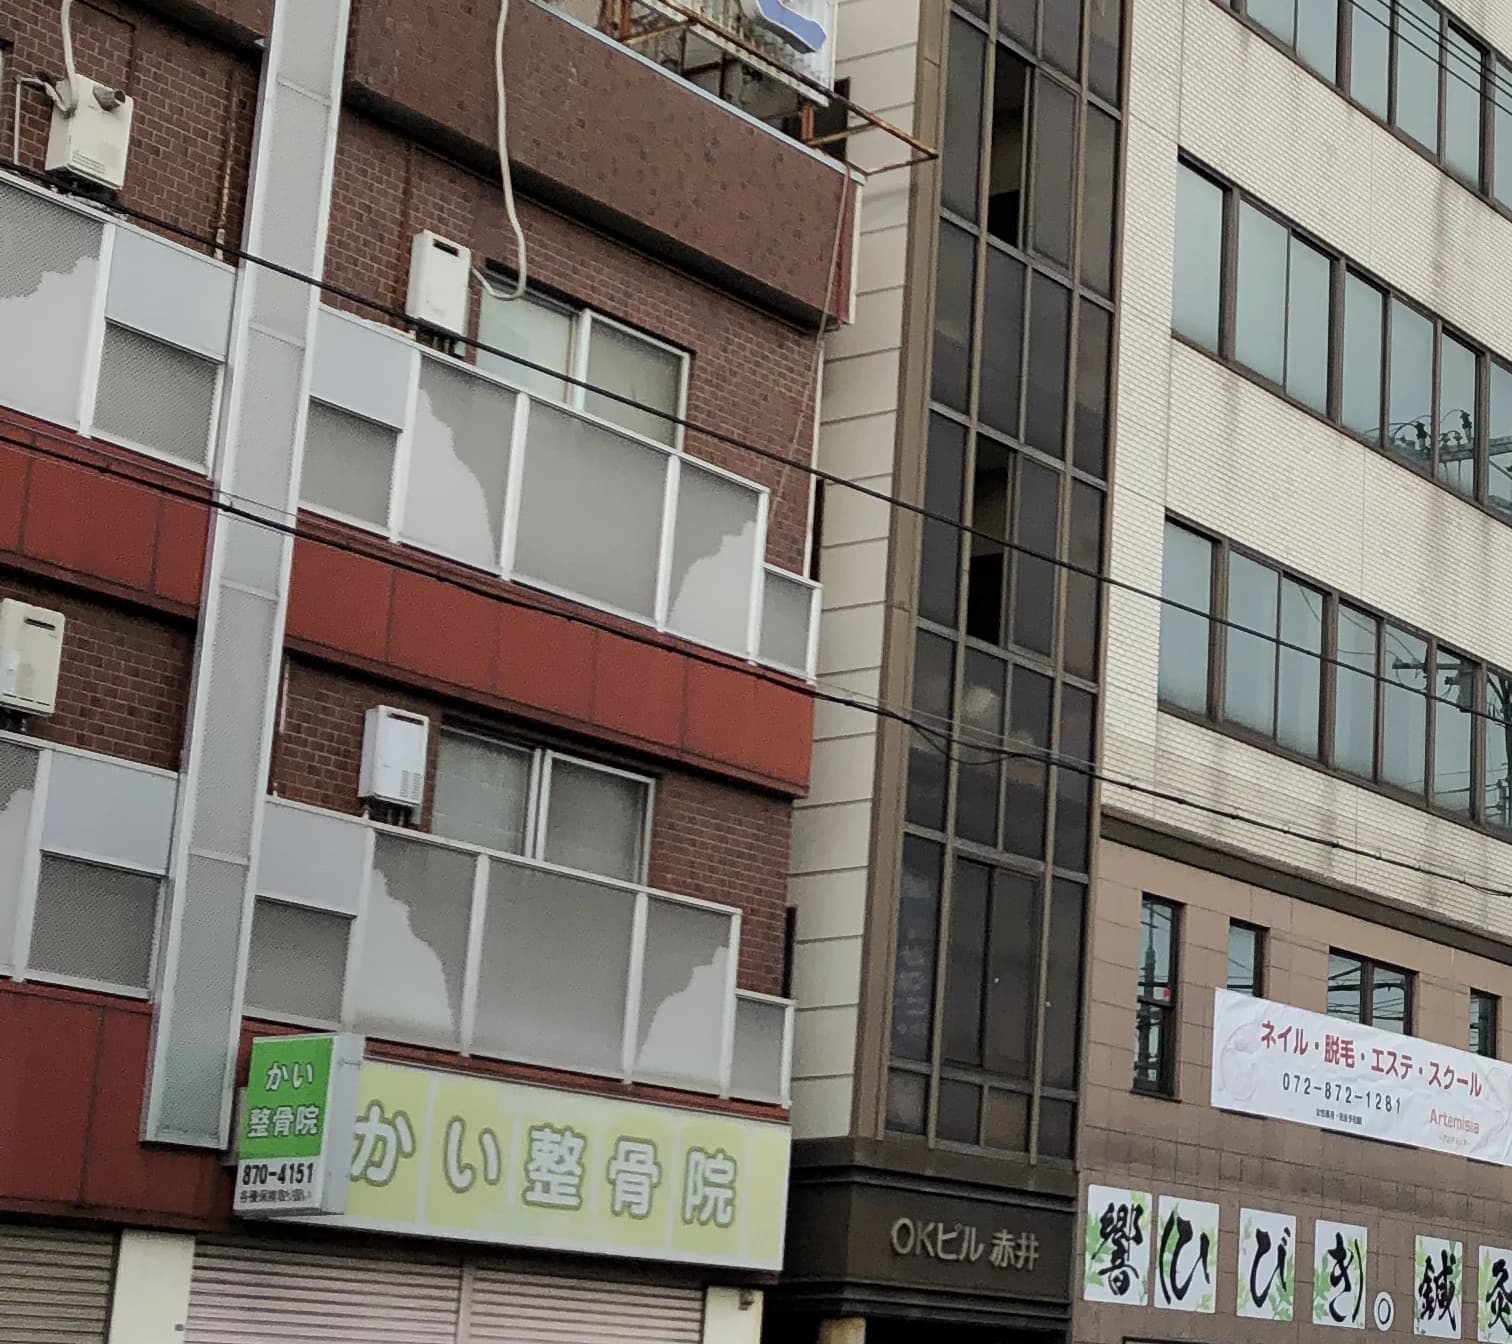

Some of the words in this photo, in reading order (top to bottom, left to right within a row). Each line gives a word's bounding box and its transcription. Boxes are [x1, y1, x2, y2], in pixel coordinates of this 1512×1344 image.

[1260, 1020, 1482, 1097] ネイル・脱毛・エステ・スクール
[264, 1061, 314, 1091] かい
[1282, 1071, 1402, 1115] 072-872-1281
[247, 1104, 320, 1138] 整骨院
[1429, 1108, 1480, 1135] Artemisia
[242, 1162, 314, 1186] 870-4151
[350, 1100, 738, 1228] かい整骨院
